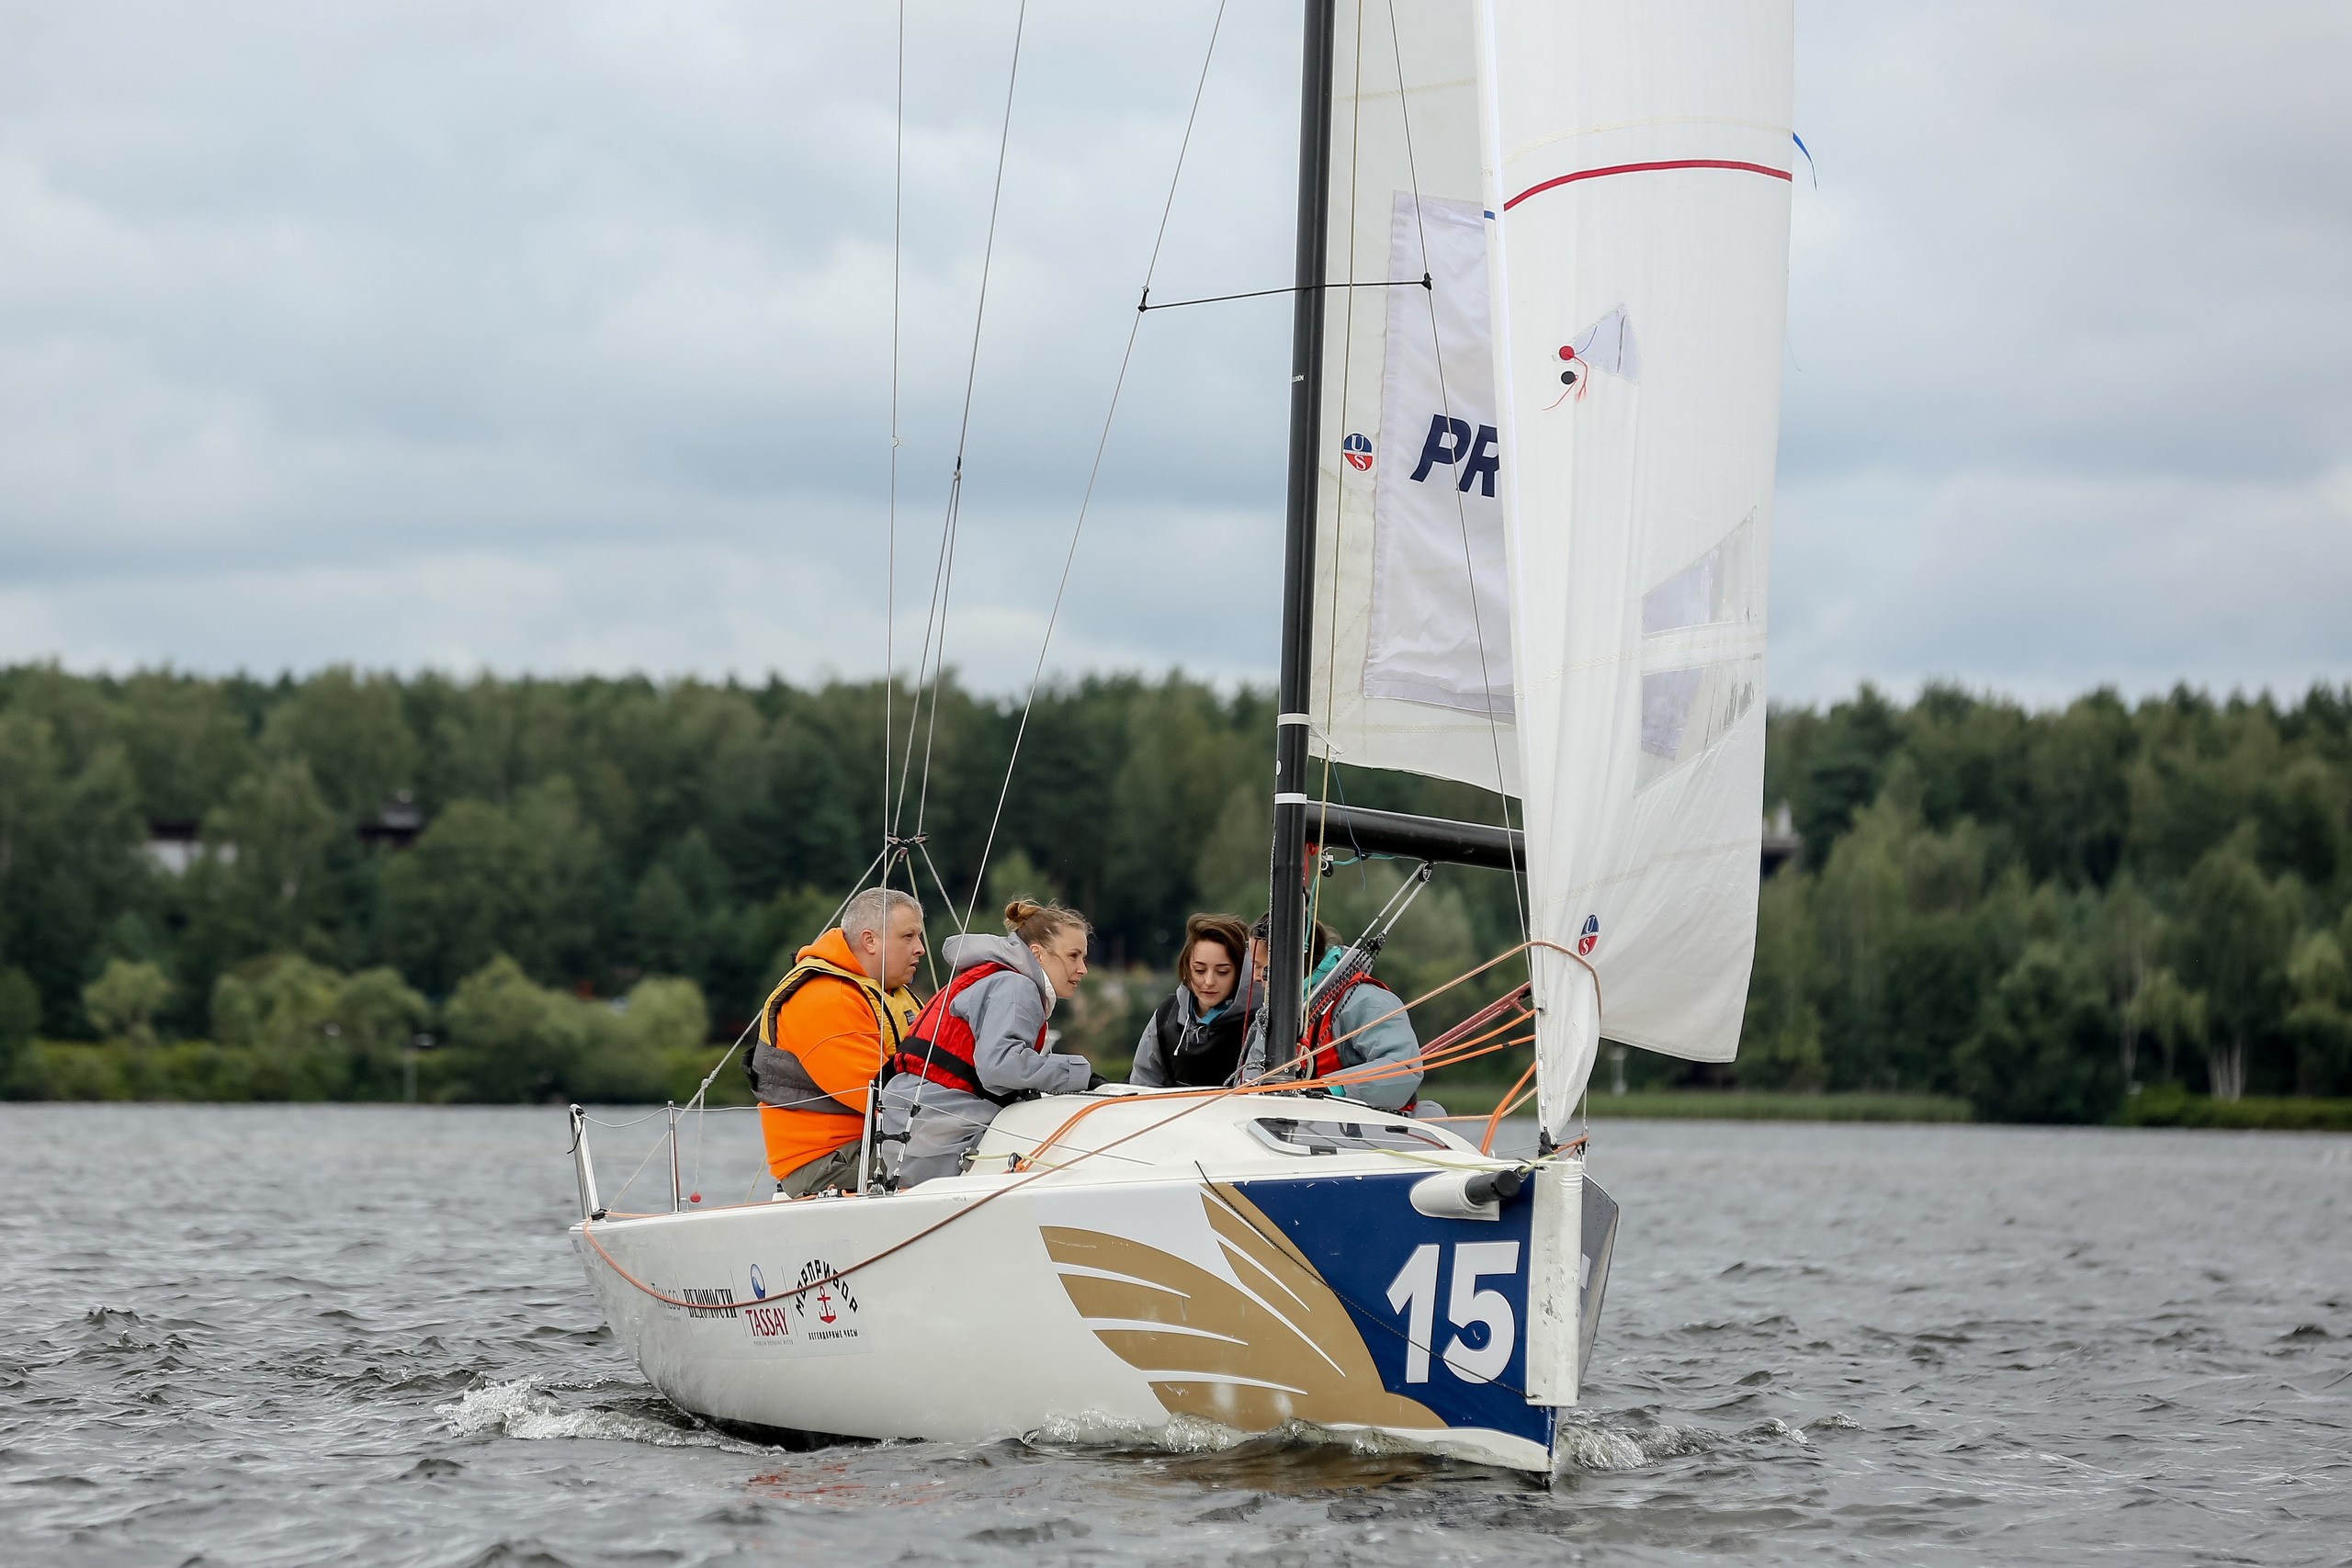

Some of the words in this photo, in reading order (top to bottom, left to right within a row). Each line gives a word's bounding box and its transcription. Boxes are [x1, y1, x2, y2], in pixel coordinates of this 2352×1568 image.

[1351, 434, 1364, 451] U
[1353, 455, 1366, 470] S
[683, 1288, 738, 1319] ВЕДОМОСТИ
[1385, 1240, 1521, 1384] 15
[745, 1307, 789, 1337] TASSAY
